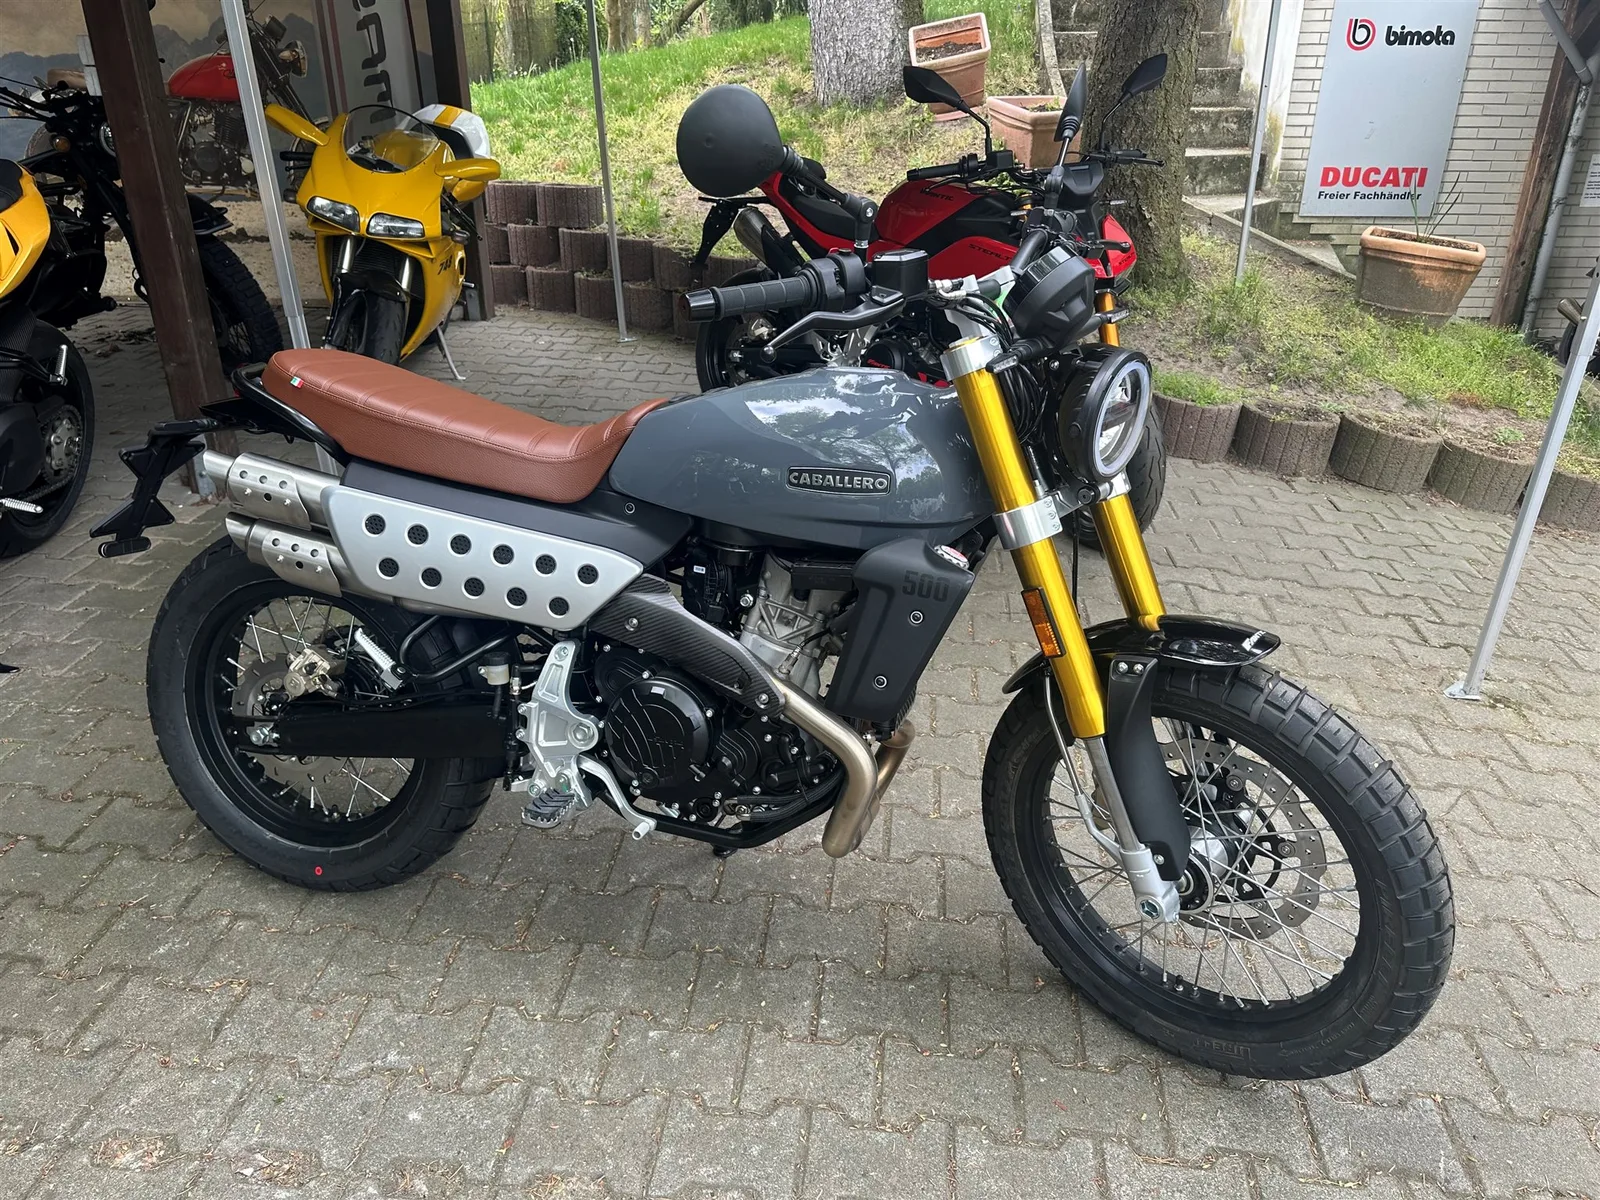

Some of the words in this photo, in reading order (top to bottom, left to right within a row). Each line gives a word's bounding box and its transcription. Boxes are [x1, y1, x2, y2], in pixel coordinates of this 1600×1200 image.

[1385, 25, 1455, 46] bimota
[352, 0, 397, 124] AM
[1320, 166, 1428, 188] DUCATI
[1317, 191, 1351, 200] Freier
[1353, 191, 1422, 200] Fachhändler
[968, 244, 1012, 260] STEALT
[789, 472, 888, 490] CABALLERO
[902, 570, 951, 602] 500
